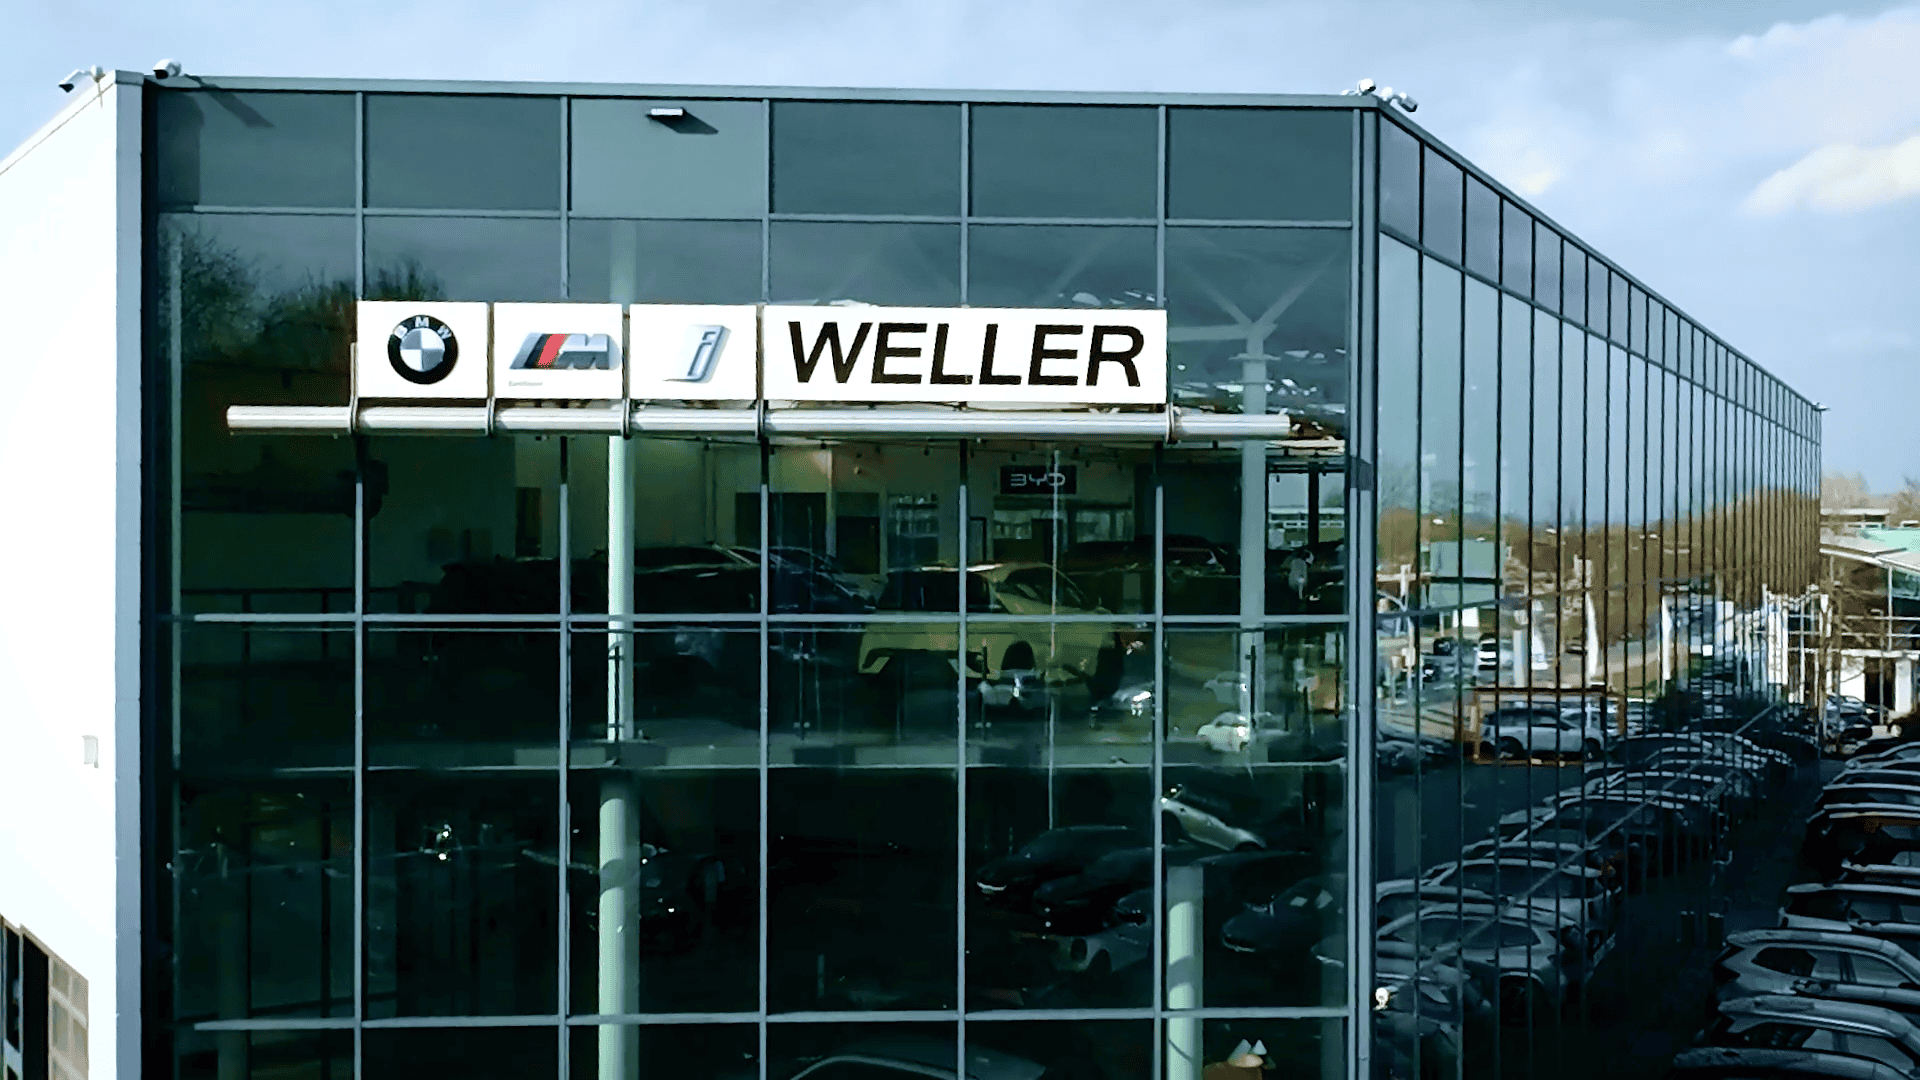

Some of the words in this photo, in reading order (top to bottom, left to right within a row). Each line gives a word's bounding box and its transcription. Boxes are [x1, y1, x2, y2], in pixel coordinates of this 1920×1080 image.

[393, 315, 452, 339] BMW
[552, 333, 609, 370] M
[788, 321, 1144, 387] WELLER
[1010, 472, 1065, 487] BYD
